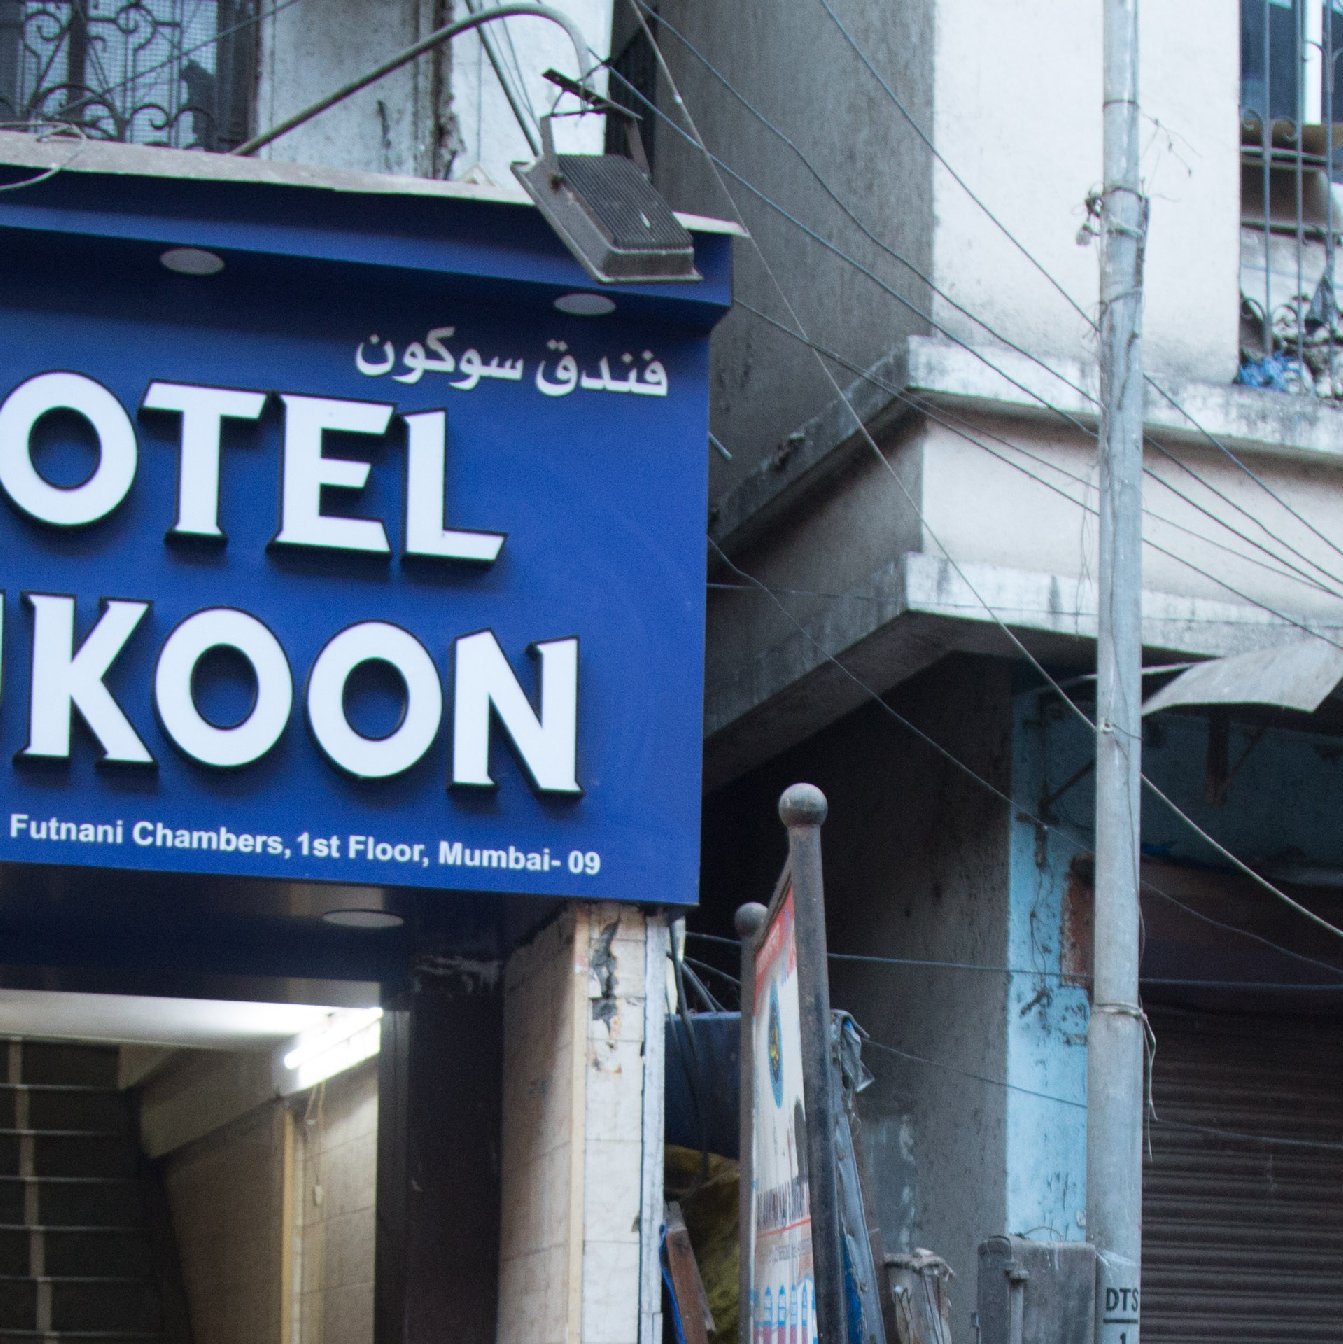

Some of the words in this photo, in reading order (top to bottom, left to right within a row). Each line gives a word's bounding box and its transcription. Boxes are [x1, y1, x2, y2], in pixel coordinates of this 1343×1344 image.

[356, 326, 524, 392] سوكون
[535, 339, 669, 398] فندق
[10, 814, 124, 844] Futnani
[133, 821, 291, 858] Chambers,
[298, 832, 341, 859] 1st
[348, 835, 429, 867] Floor,
[439, 841, 561, 872] Mumbai-
[568, 851, 602, 875] 09
[1106, 1287, 1140, 1312] DTS
